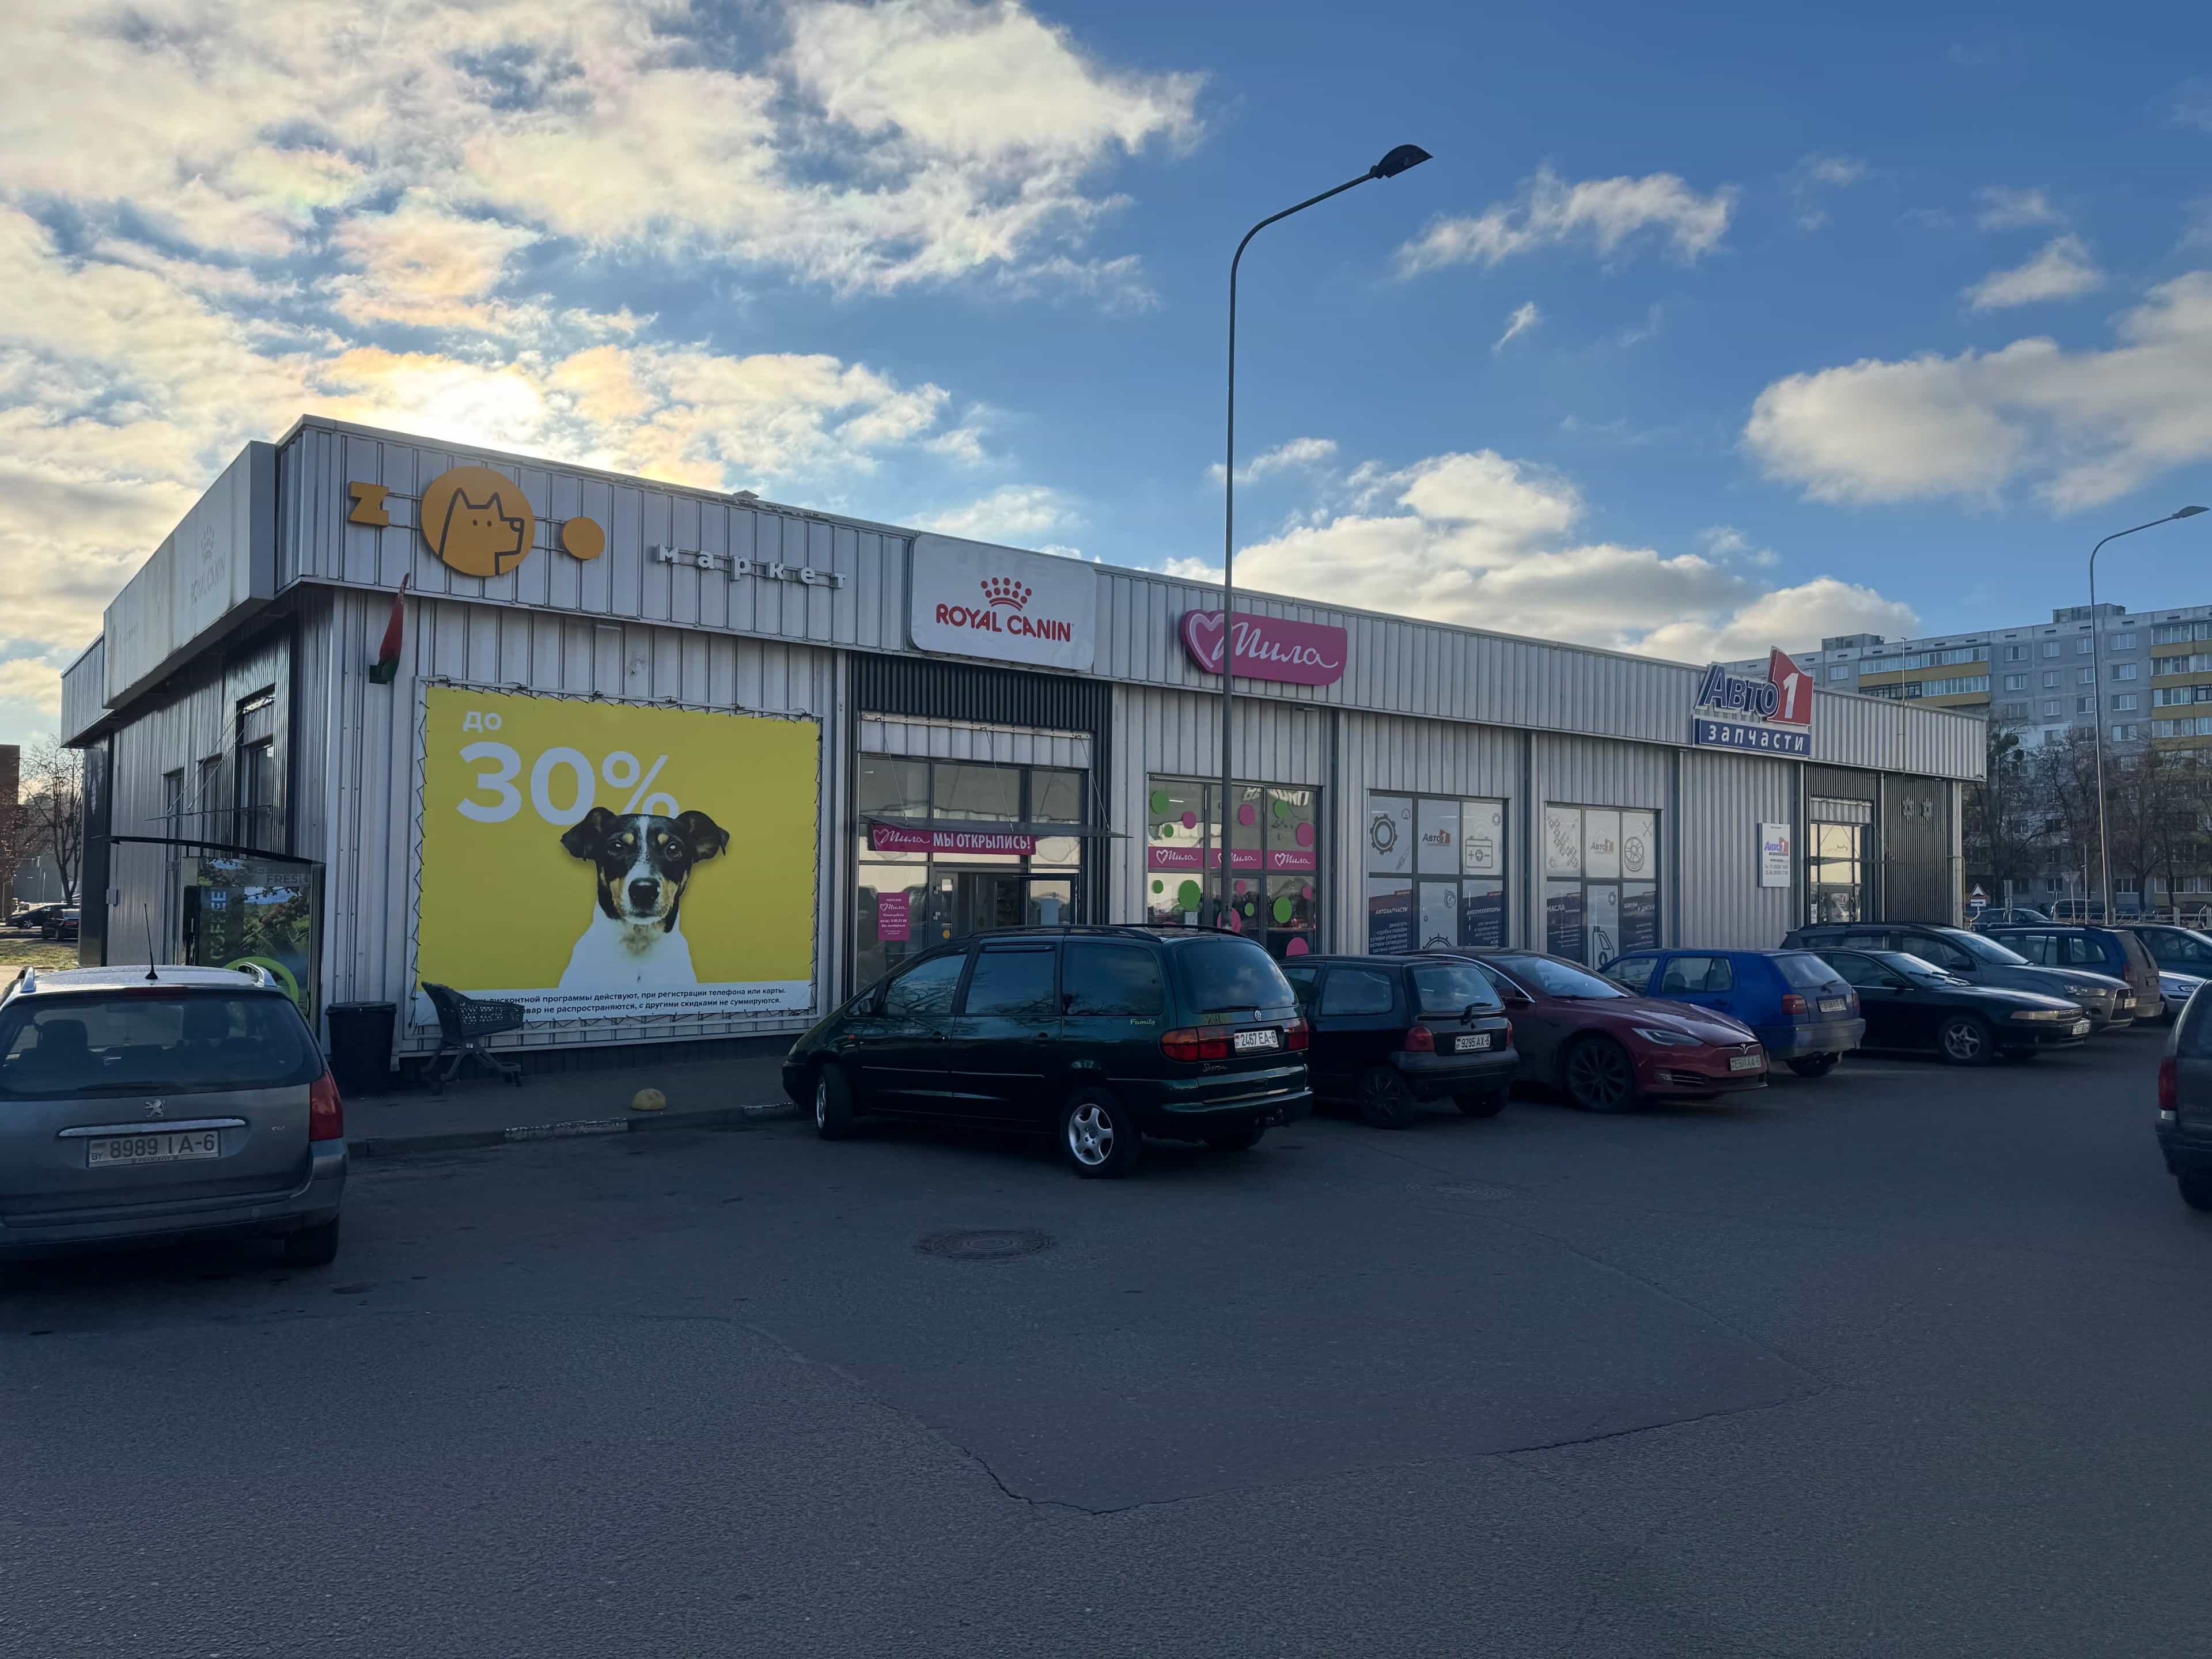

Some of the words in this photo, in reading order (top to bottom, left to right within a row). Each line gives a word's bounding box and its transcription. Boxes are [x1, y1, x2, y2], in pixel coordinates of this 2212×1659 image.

[935, 603, 1002, 633] ROYAL
[1007, 615, 1071, 642] CANIN
[1708, 724, 1804, 752] запчасти
[456, 741, 680, 825] 30%
[933, 832, 953, 847] МЫ
[957, 833, 1031, 849] ОТКРЫЛИСЬ!
[543, 994, 592, 1004] программы
[594, 992, 639, 1002] действуют,
[641, 992, 656, 1000] при
[658, 990, 707, 998] регистрации
[709, 987, 745, 997] телефона
[557, 1003, 636, 1014] распространяются,
[645, 1001, 679, 1009] другими
[681, 999, 718, 1007] скидками
[730, 998, 781, 1006] суммируются.
[1130, 1018, 1156, 1027] Family
[1241, 1032, 1257, 1046] 2467
[1461, 1037, 1475, 1048] 9295
[91, 1152, 103, 1161] BY
[109, 1137, 158, 1159] 8989
